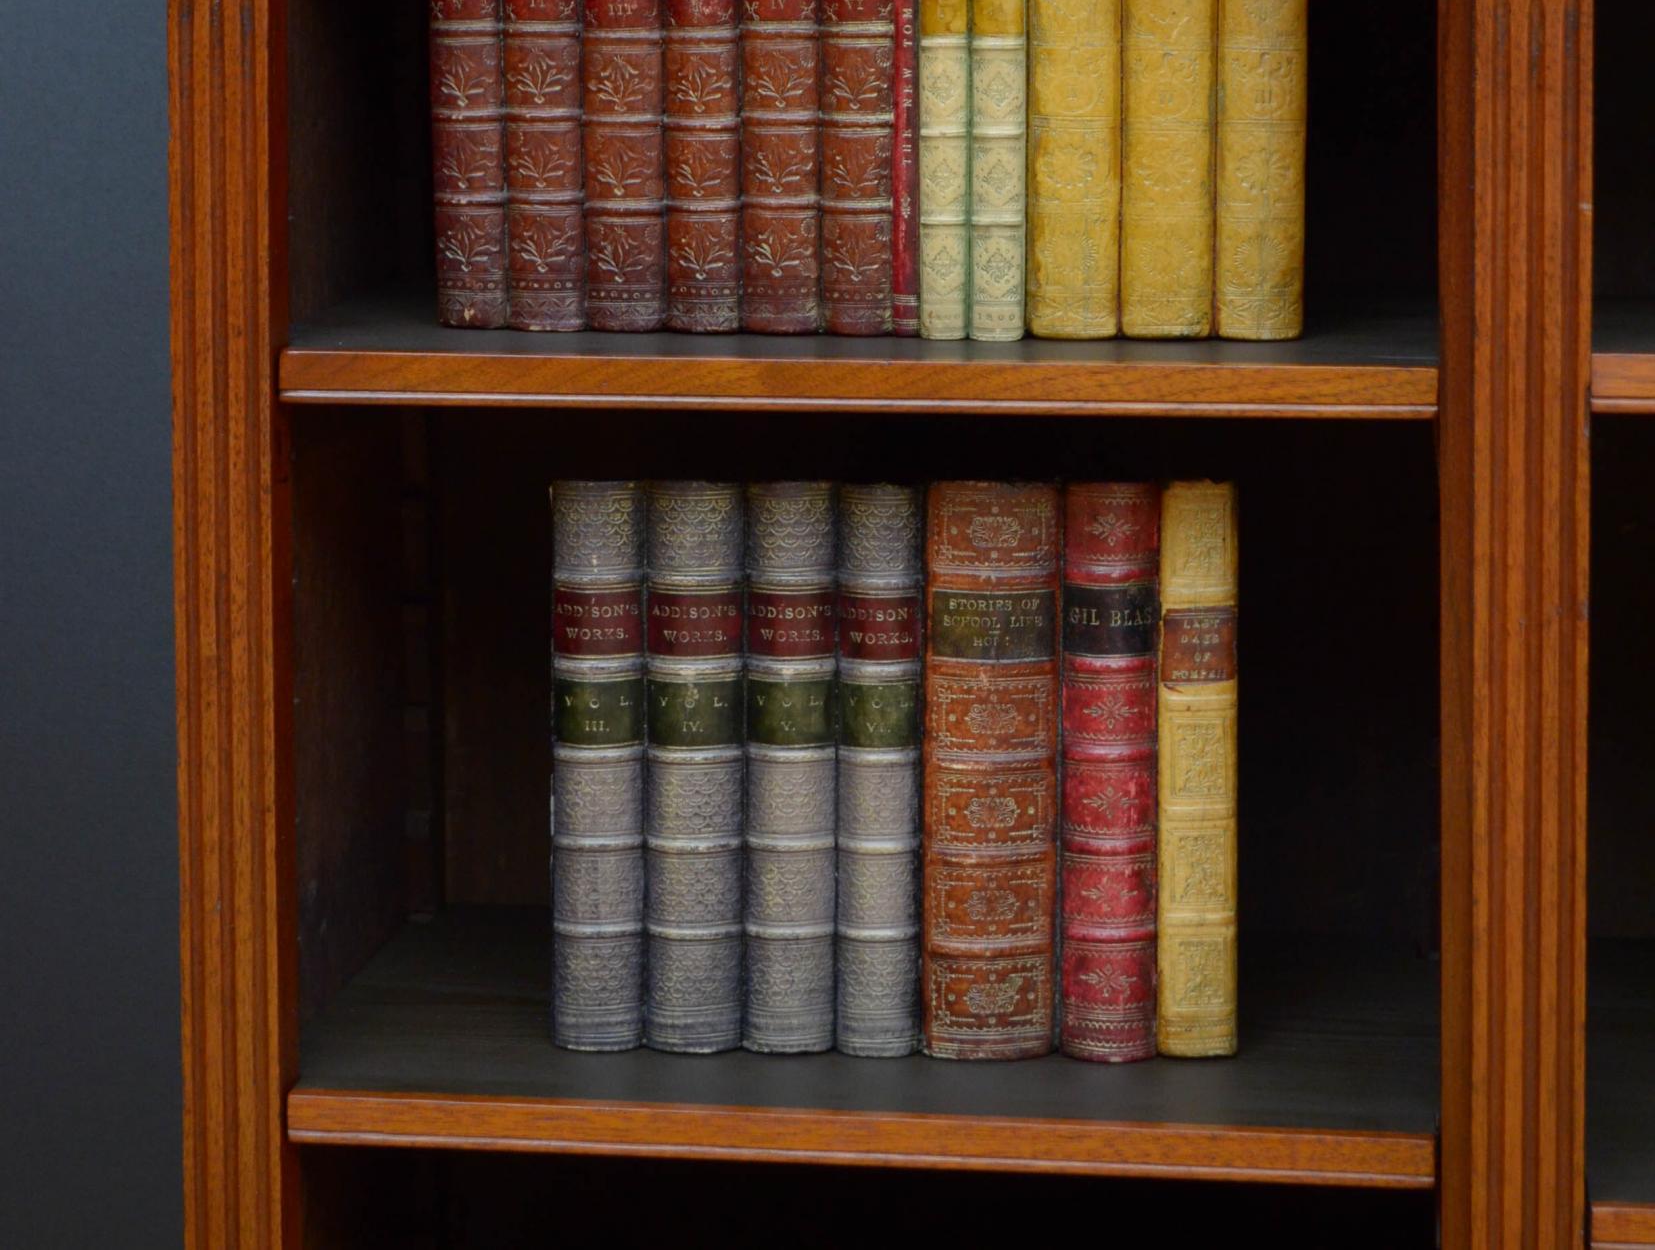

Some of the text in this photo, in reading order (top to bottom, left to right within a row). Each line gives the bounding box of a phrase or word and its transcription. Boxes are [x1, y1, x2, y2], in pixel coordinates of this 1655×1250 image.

[901, 7, 913, 48] TOM
[901, 66, 913, 110] NEW
[901, 127, 913, 168] THE
[555, 603, 638, 618] ADDISON'S
[651, 604, 736, 619] ADDISON'S
[750, 605, 831, 619] ADDISON'S
[949, 598, 1040, 612] STORIES OF
[1070, 608, 1153, 628] GIL BLAS
[565, 627, 629, 641] WORKS.
[760, 628, 825, 643] WORKS.
[850, 631, 912, 645] WORKS.
[584, 720, 610, 733] III.
[681, 720, 704, 733] IV.
